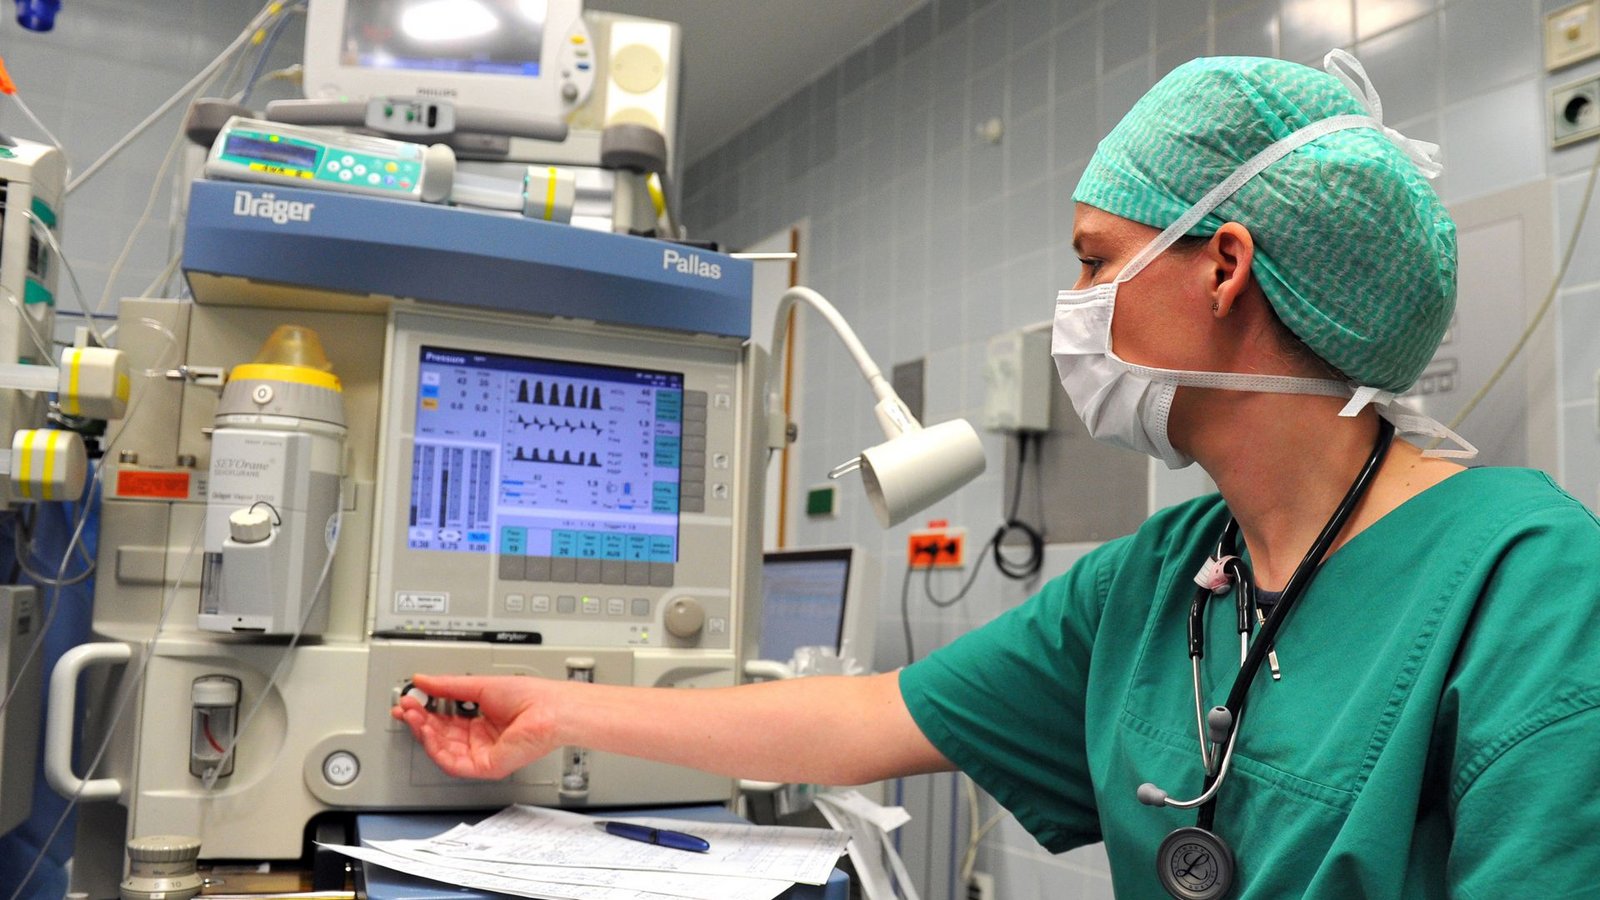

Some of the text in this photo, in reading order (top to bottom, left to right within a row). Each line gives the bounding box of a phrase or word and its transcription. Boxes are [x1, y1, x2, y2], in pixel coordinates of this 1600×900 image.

[233, 190, 315, 224] Dräger
[663, 248, 721, 279] Pallas
[425, 351, 466, 364] Pressure
